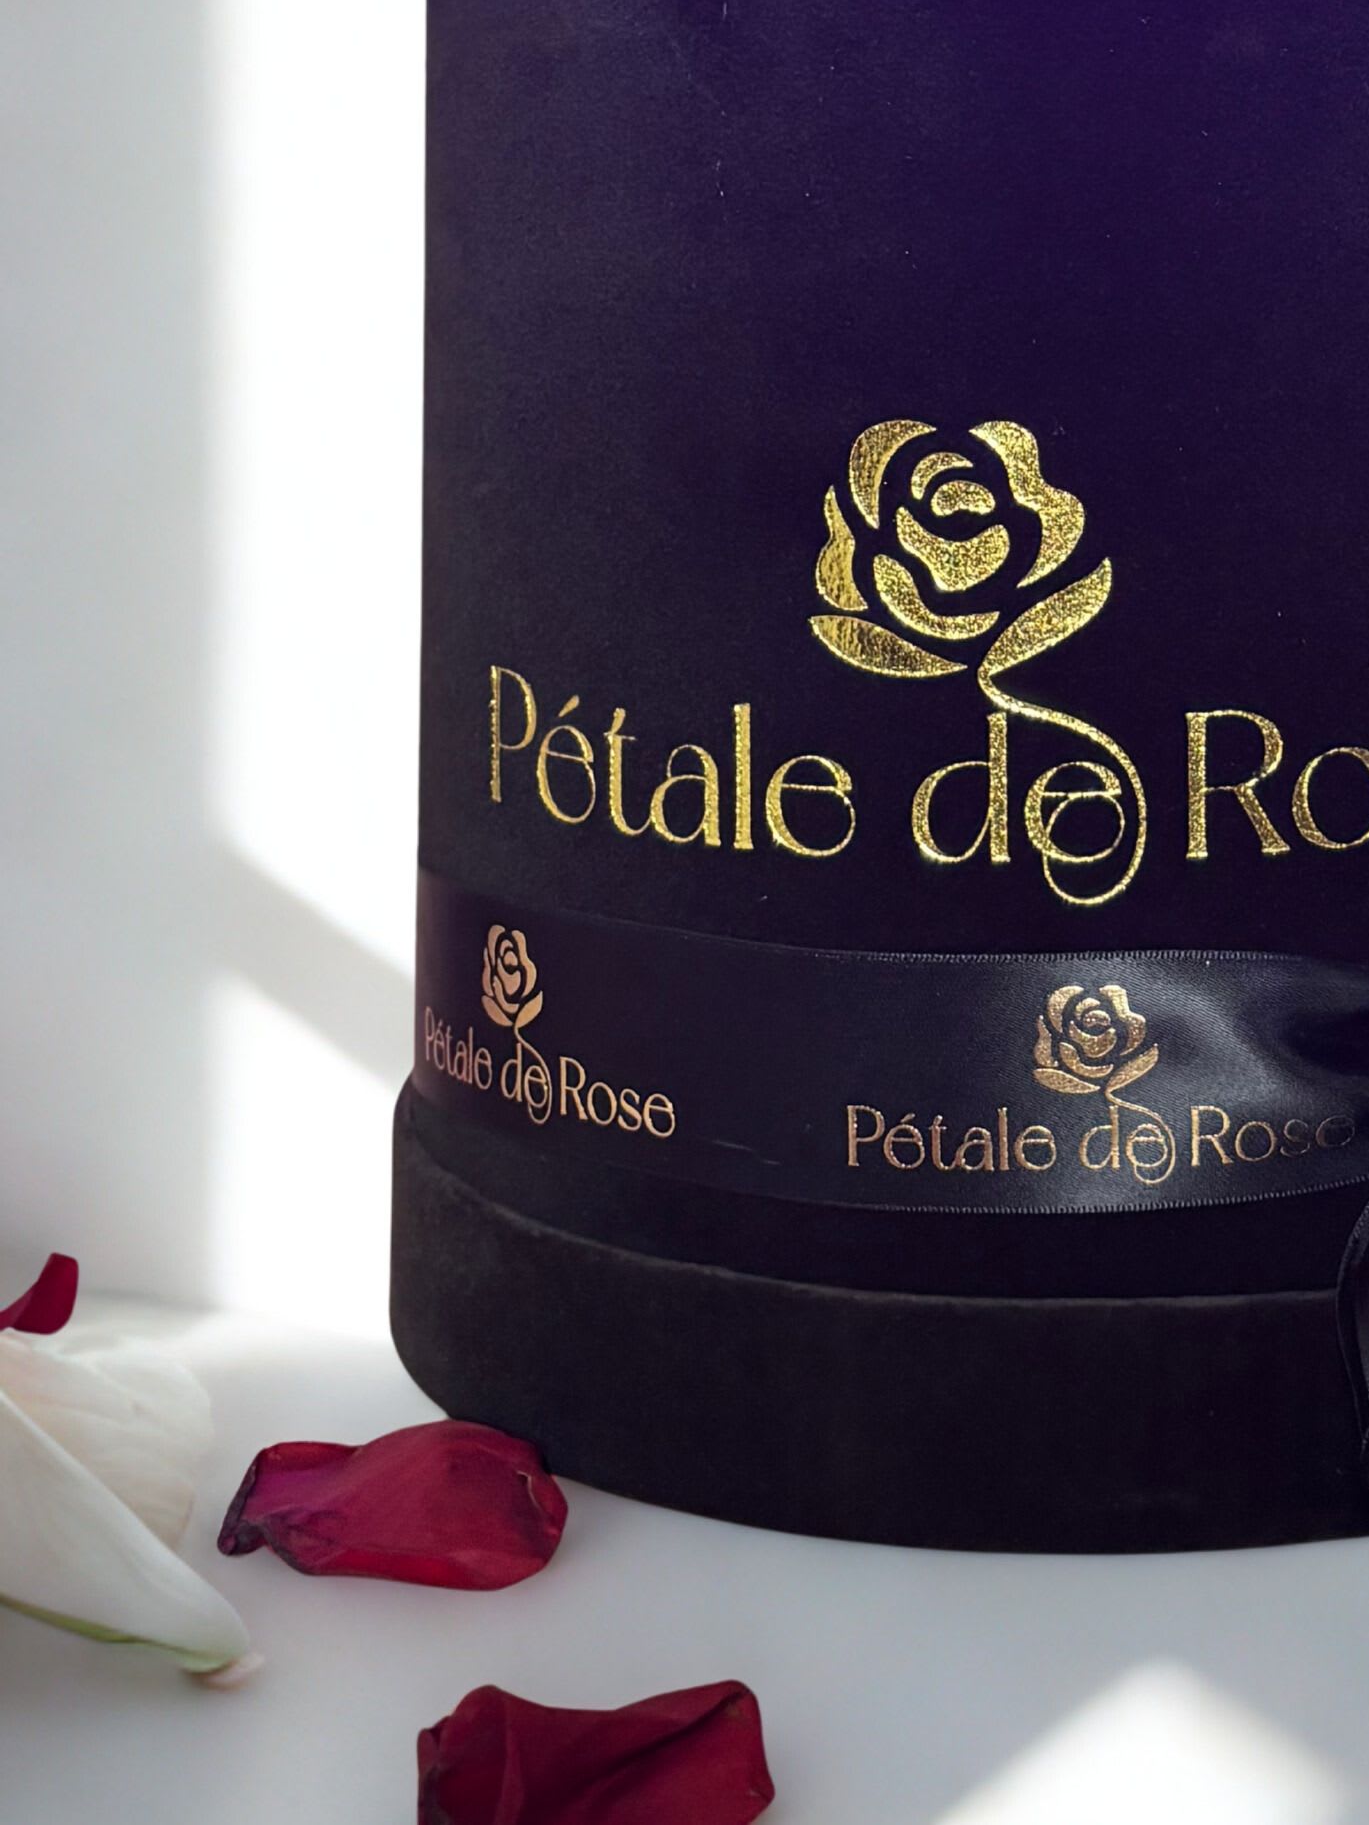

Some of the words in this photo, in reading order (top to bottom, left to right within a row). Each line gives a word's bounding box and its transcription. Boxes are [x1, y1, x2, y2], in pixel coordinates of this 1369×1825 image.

[489, 664, 857, 858] Pétale
[910, 697, 1148, 906] de
[424, 1005, 493, 1091] Pétale
[501, 1038, 552, 1125] de
[558, 1055, 677, 1138] Rose
[845, 1103, 1058, 1173] Pétale
[1078, 1103, 1176, 1186] de
[1189, 1104, 1356, 1168] Rose
